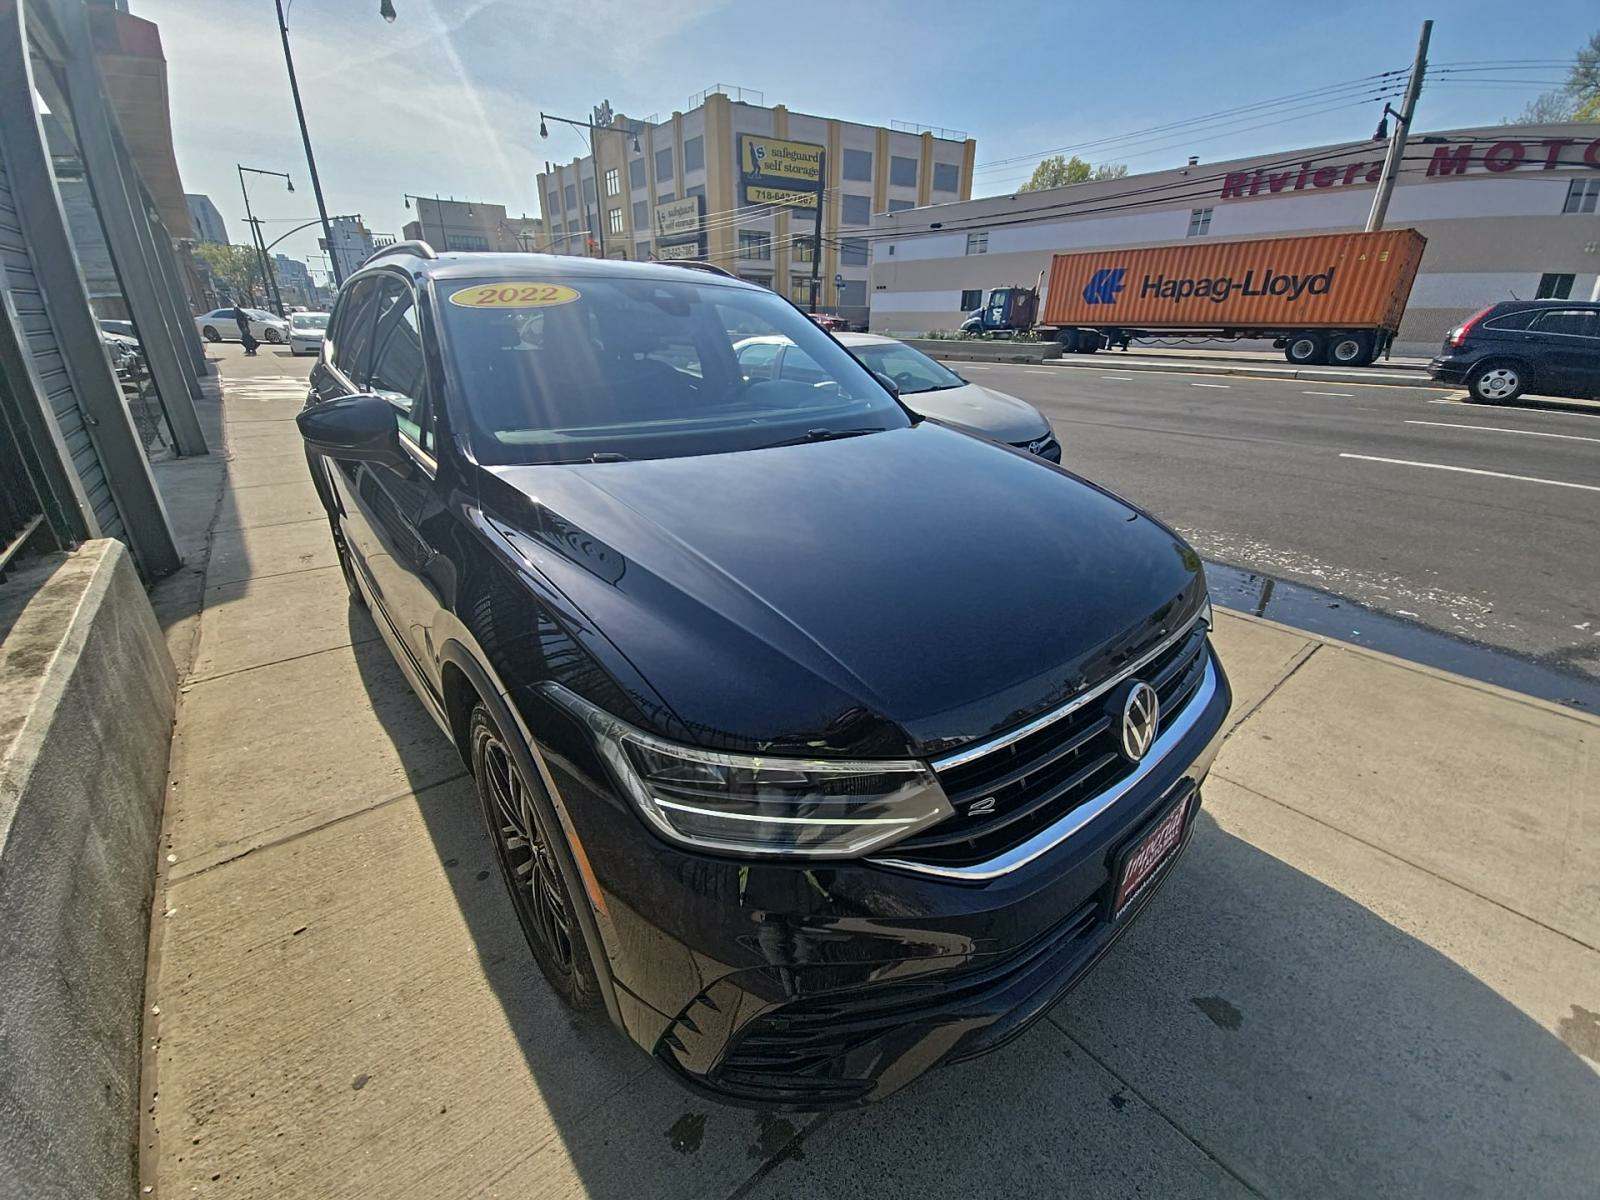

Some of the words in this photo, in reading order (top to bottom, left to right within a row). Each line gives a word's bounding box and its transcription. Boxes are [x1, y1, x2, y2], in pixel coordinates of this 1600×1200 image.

[771, 147, 819, 163] safeguard
[764, 160, 783, 171] self
[784, 163, 819, 178] storage
[1220, 161, 1384, 198] Riviera
[1140, 266, 1335, 303] Hapag-Lloyd
[476, 287, 558, 304] 2022
